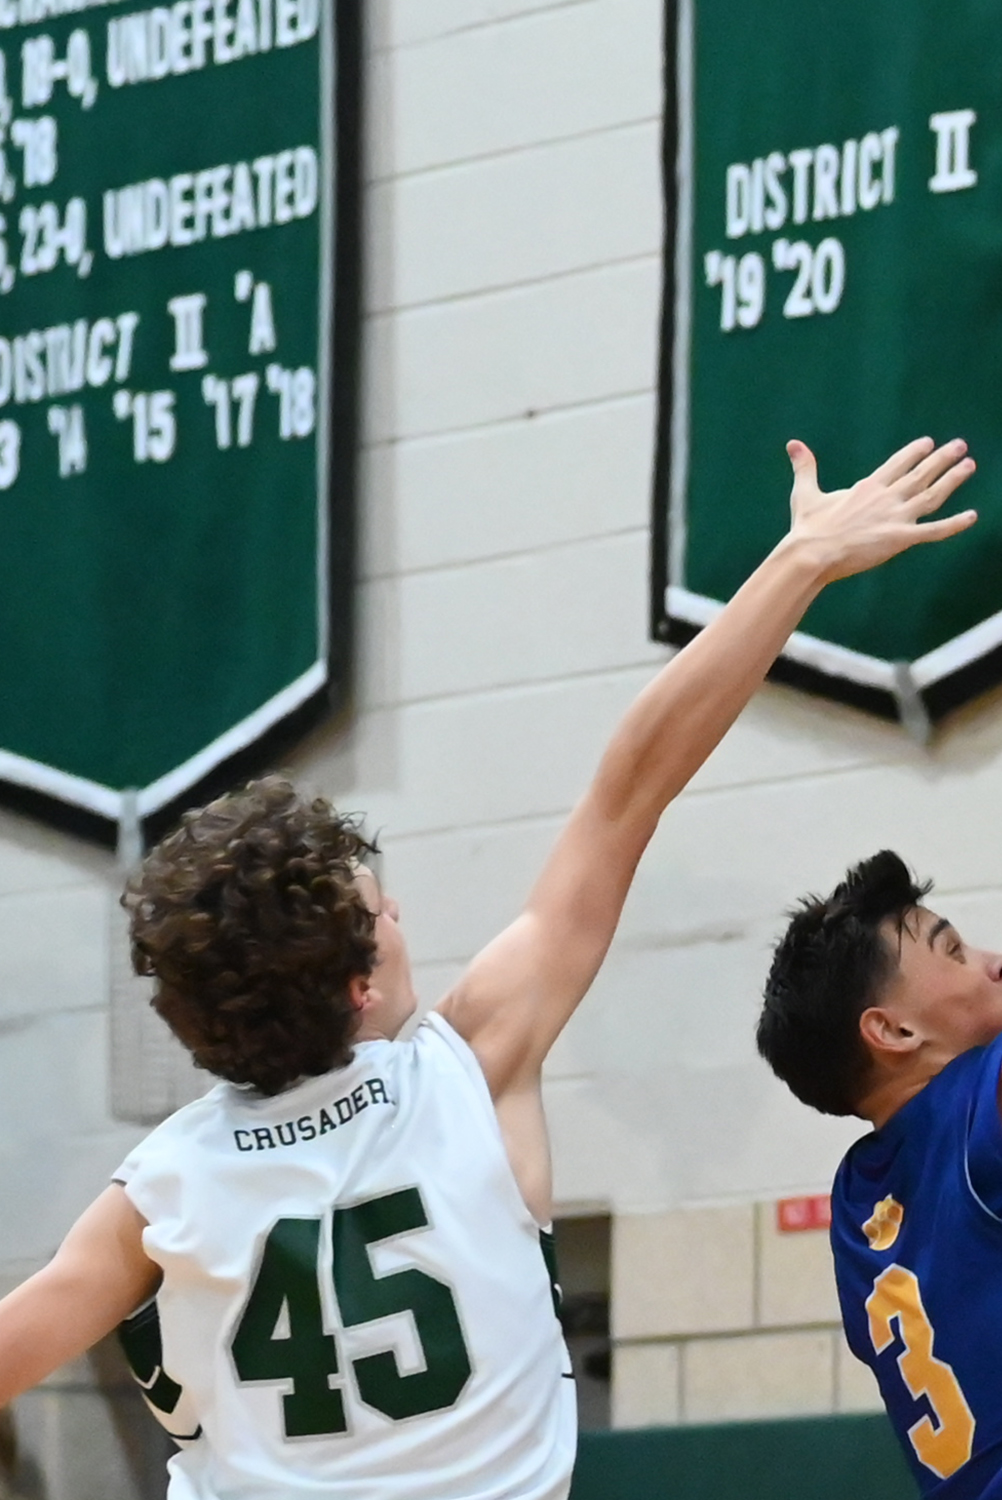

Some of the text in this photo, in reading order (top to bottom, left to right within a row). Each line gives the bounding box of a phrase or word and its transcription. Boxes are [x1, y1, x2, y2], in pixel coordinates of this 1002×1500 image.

[106, 0, 319, 88] UNDEFEATED
[102, 145, 319, 260] UNDEFEATED
[725, 125, 899, 239] DISTRICT
[928, 108, 978, 193] II
[703, 236, 846, 332] '19 '20
[112, 388, 177, 464] '15
[201, 371, 260, 451] '17
[264, 362, 316, 441] '18
[233, 1077, 396, 1152] CRUSADER
[229, 1183, 474, 1442] 45
[865, 1262, 976, 1480] 3
